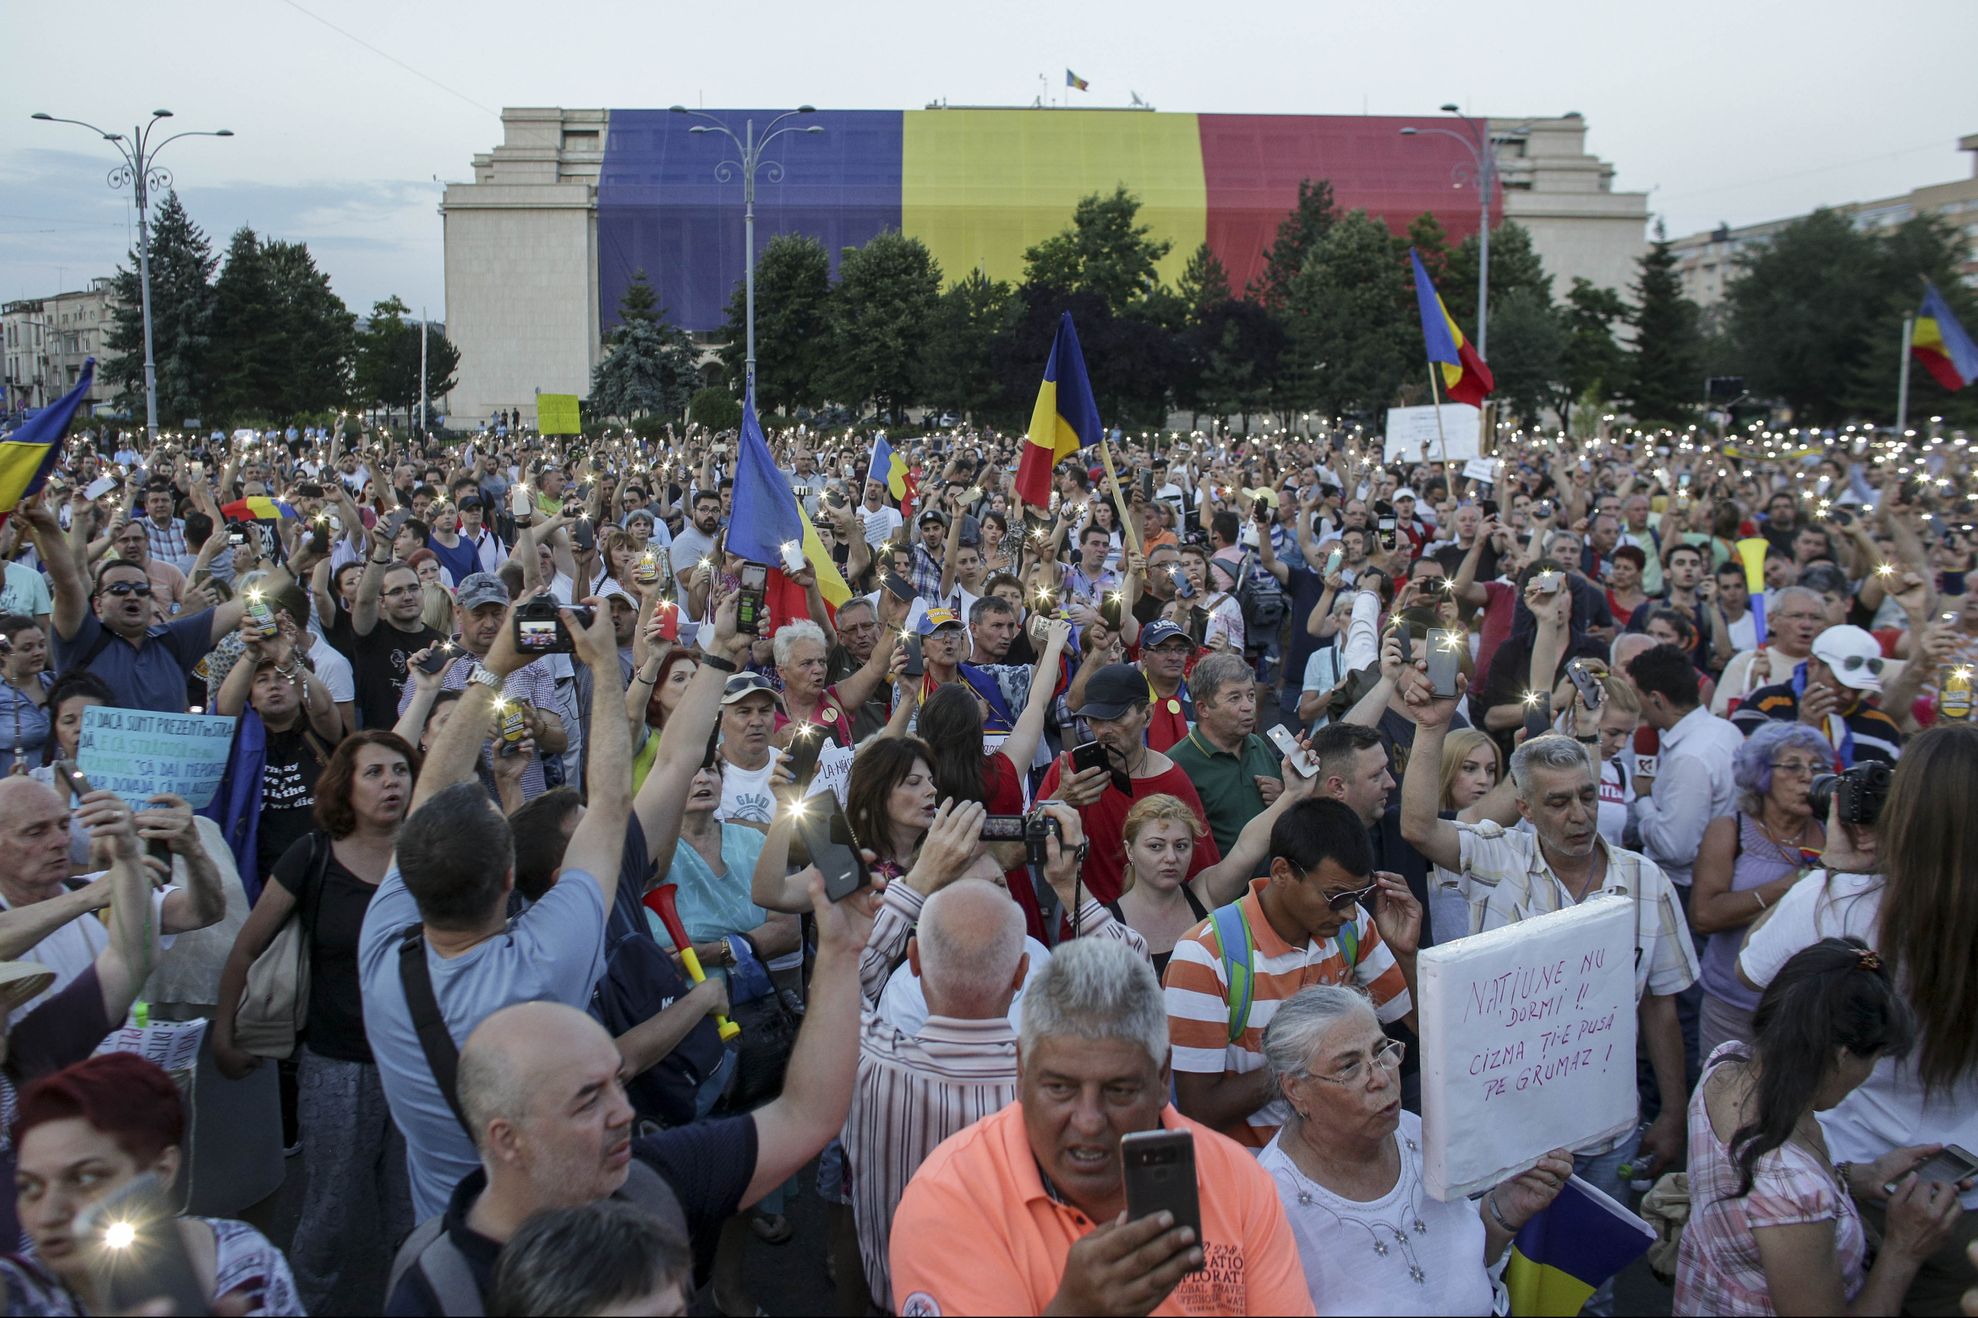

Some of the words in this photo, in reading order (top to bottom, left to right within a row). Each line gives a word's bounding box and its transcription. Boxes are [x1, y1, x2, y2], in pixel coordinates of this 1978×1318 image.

[282, 785, 306, 797] the
[1580, 948, 1606, 976] NU
[1469, 1040, 1525, 1076] CIZMA
[1484, 1078, 1506, 1101] PE
[1516, 1048, 1593, 1092] GRUMAZ
[1204, 1256, 1244, 1270] ATIO
